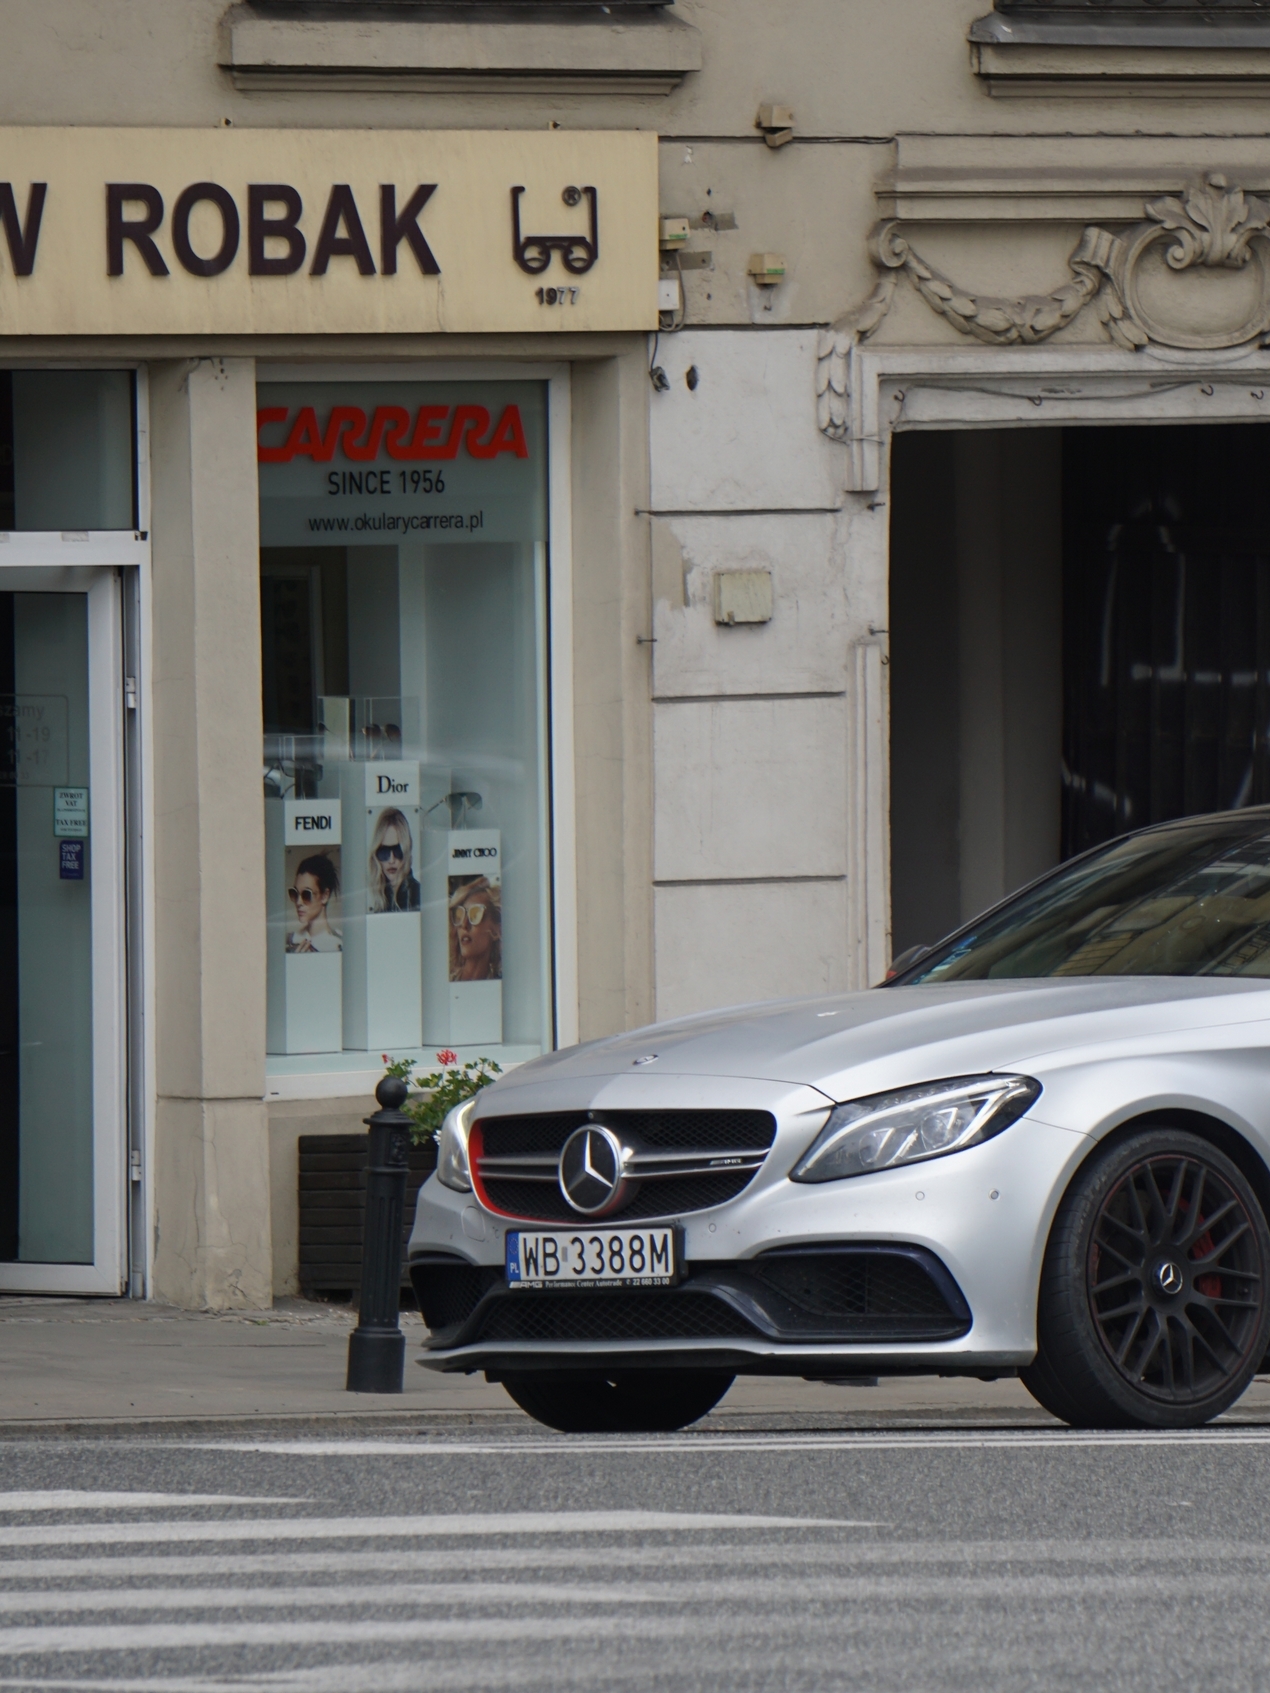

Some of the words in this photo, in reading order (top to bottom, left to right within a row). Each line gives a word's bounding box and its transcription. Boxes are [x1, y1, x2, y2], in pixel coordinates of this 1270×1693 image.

[106, 183, 440, 277] ROBAK
[535, 286, 580, 305] 1977
[258, 404, 529, 463] CARRERA
[328, 471, 391, 495] SINCE
[399, 469, 445, 494] 1956
[309, 511, 483, 534] www.okularycarrera.pl
[377, 775, 409, 793] Dior
[295, 816, 331, 830] FENDI
[61, 844, 82, 853] SHOP
[61, 853, 77, 861] TAX
[61, 861, 80, 869] FREE
[523, 1237, 560, 1276] WB
[570, 1233, 669, 1275] 3388M
[510, 1262, 519, 1273] PL
